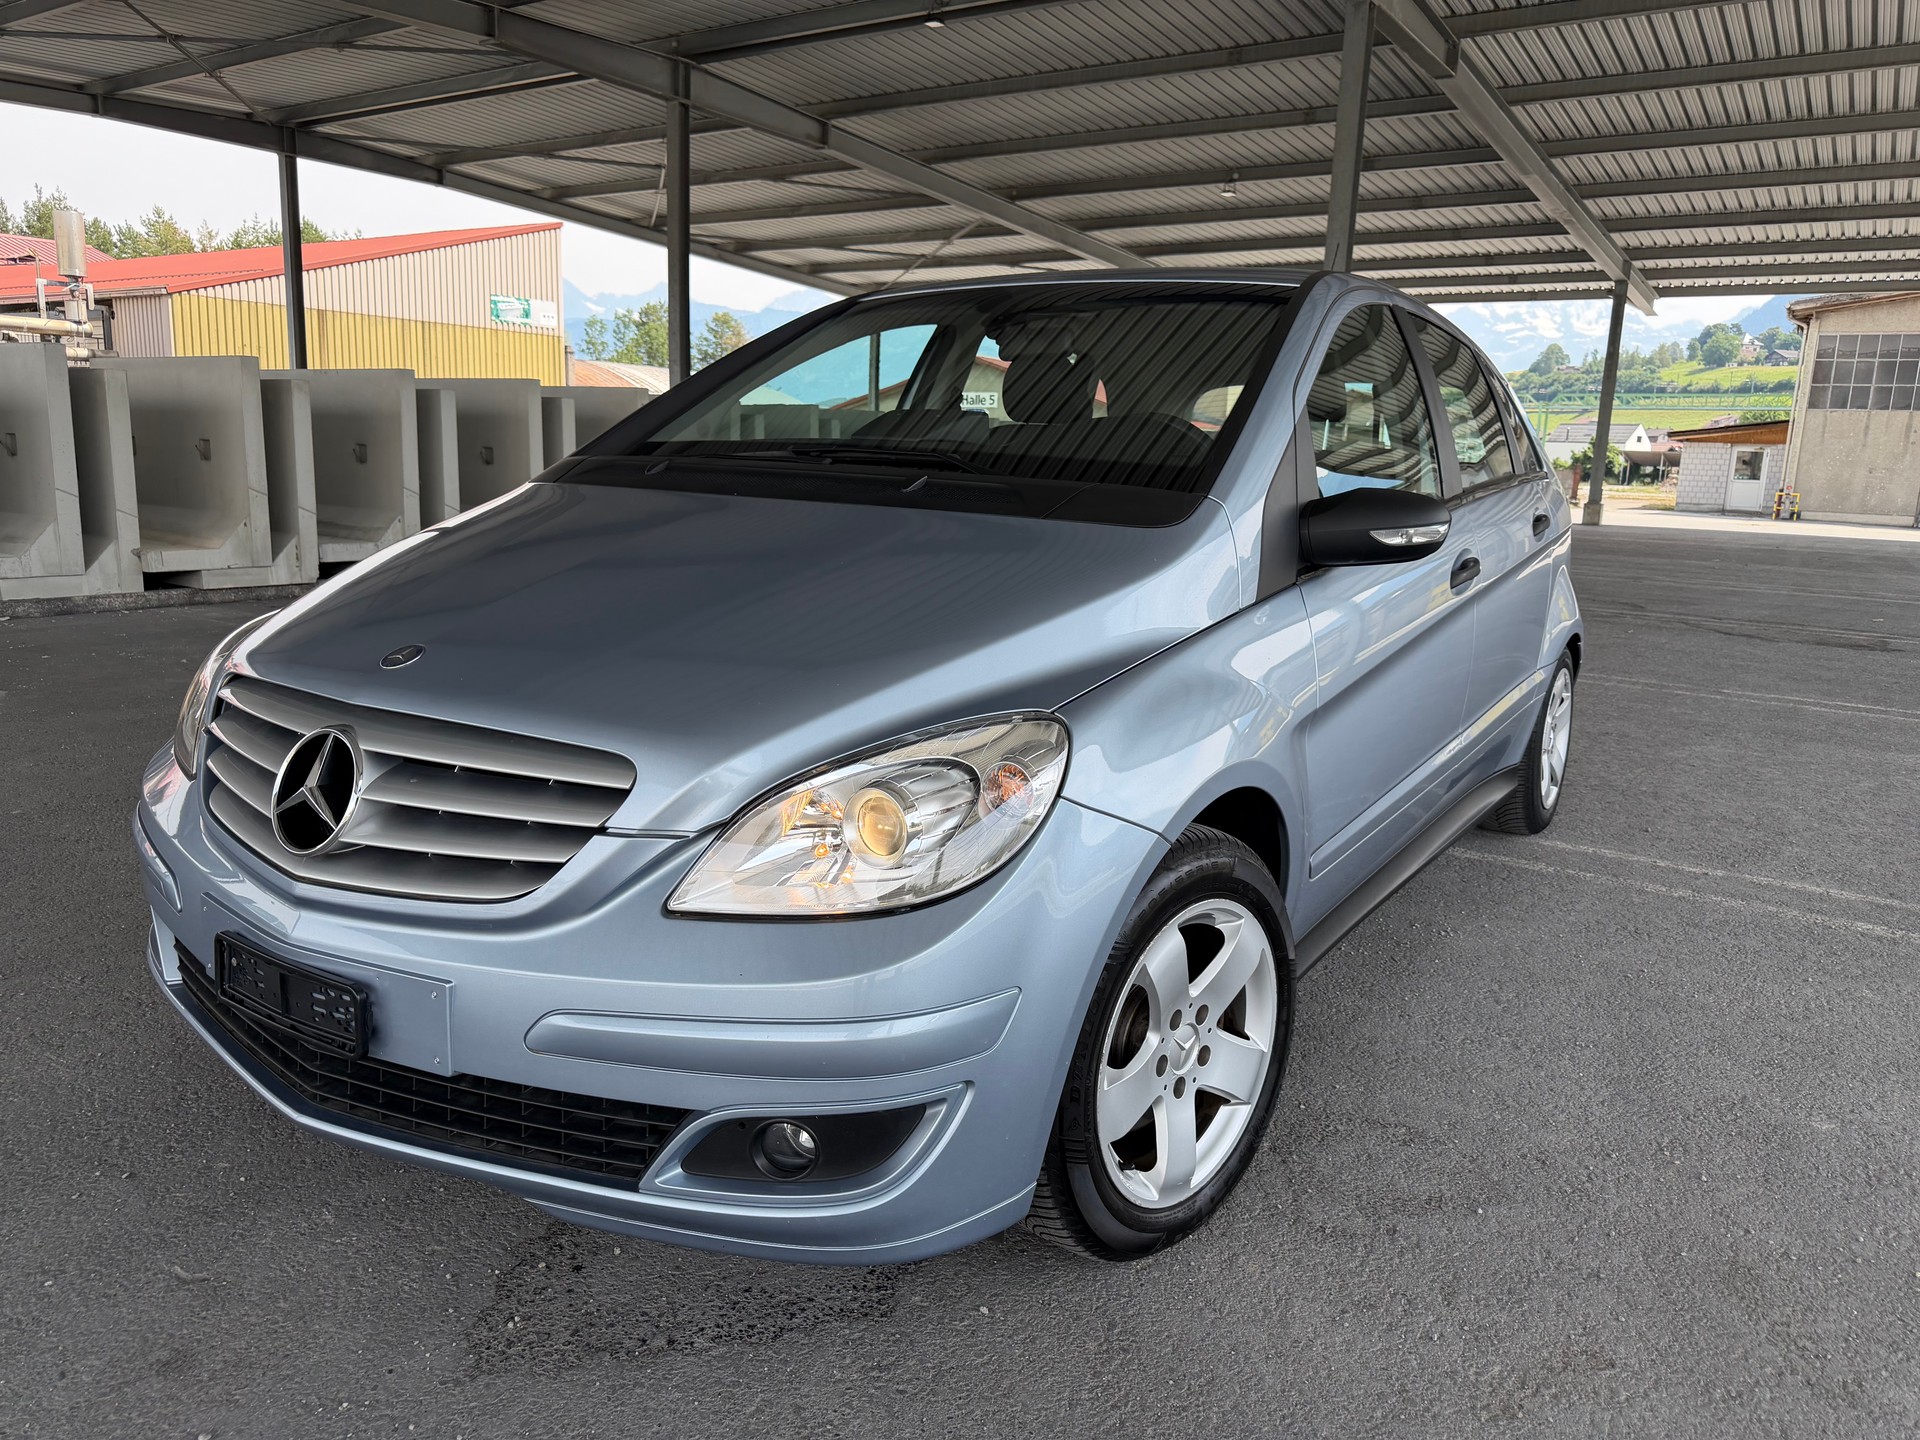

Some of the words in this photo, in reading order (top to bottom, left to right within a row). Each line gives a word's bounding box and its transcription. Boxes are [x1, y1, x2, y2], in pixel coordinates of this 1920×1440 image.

[962, 394, 986, 405] Halle
[989, 394, 995, 405] 5
[1070, 969, 1108, 1104] DUNLOP
